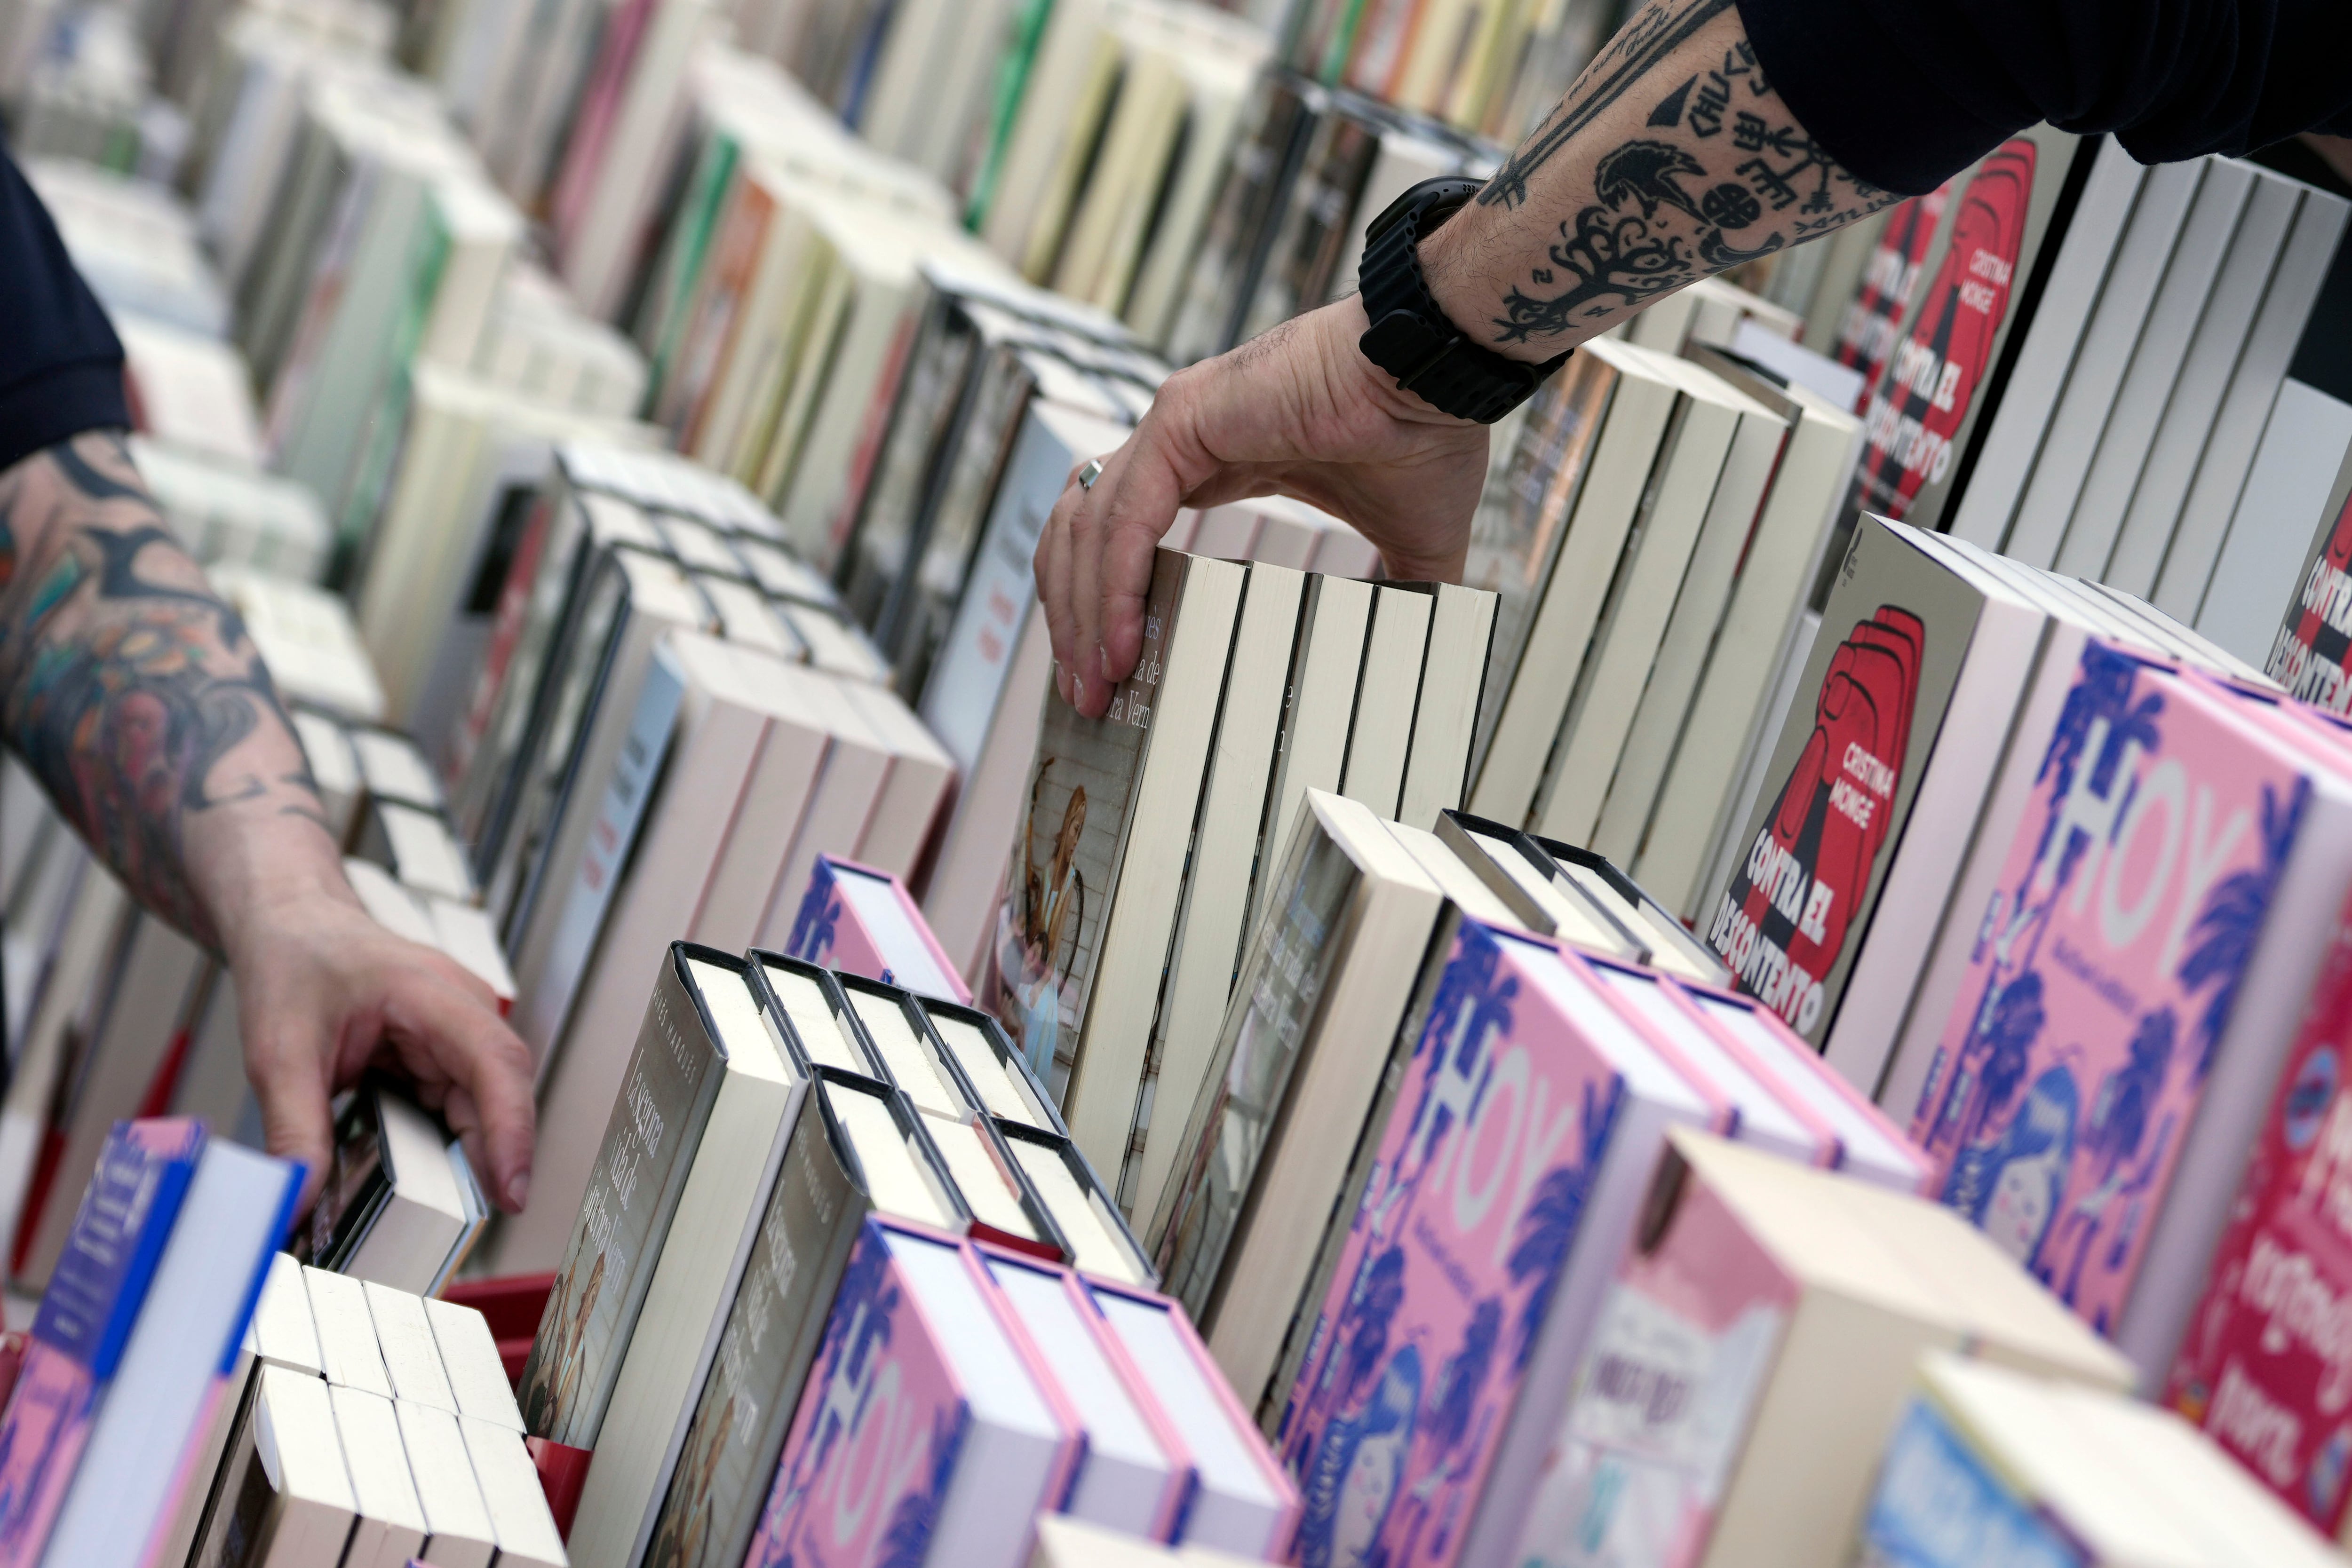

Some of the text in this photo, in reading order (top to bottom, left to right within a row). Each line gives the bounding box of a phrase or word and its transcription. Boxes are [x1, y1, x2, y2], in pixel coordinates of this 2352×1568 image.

[1932, 360, 1963, 413] EL
[1127, 689, 1151, 729] Vern
[1146, 650, 1160, 685] de
[1828, 776, 1875, 829] MONGE
[1843, 742, 1895, 800] CRISTINA
[1746, 828, 1835, 947] CONTRA EL
[2039, 716, 2250, 978] HOY
[1709, 890, 1826, 1034] DESCONTENTO
[666, 1021, 696, 1085] MARQUÈS
[627, 1047, 664, 1159] La segona
[1411, 994, 1574, 1267] HOY
[608, 1126, 640, 1212] vida de
[584, 1160, 626, 1295] Ginebra Vern
[802, 1302, 929, 1568] HOY
